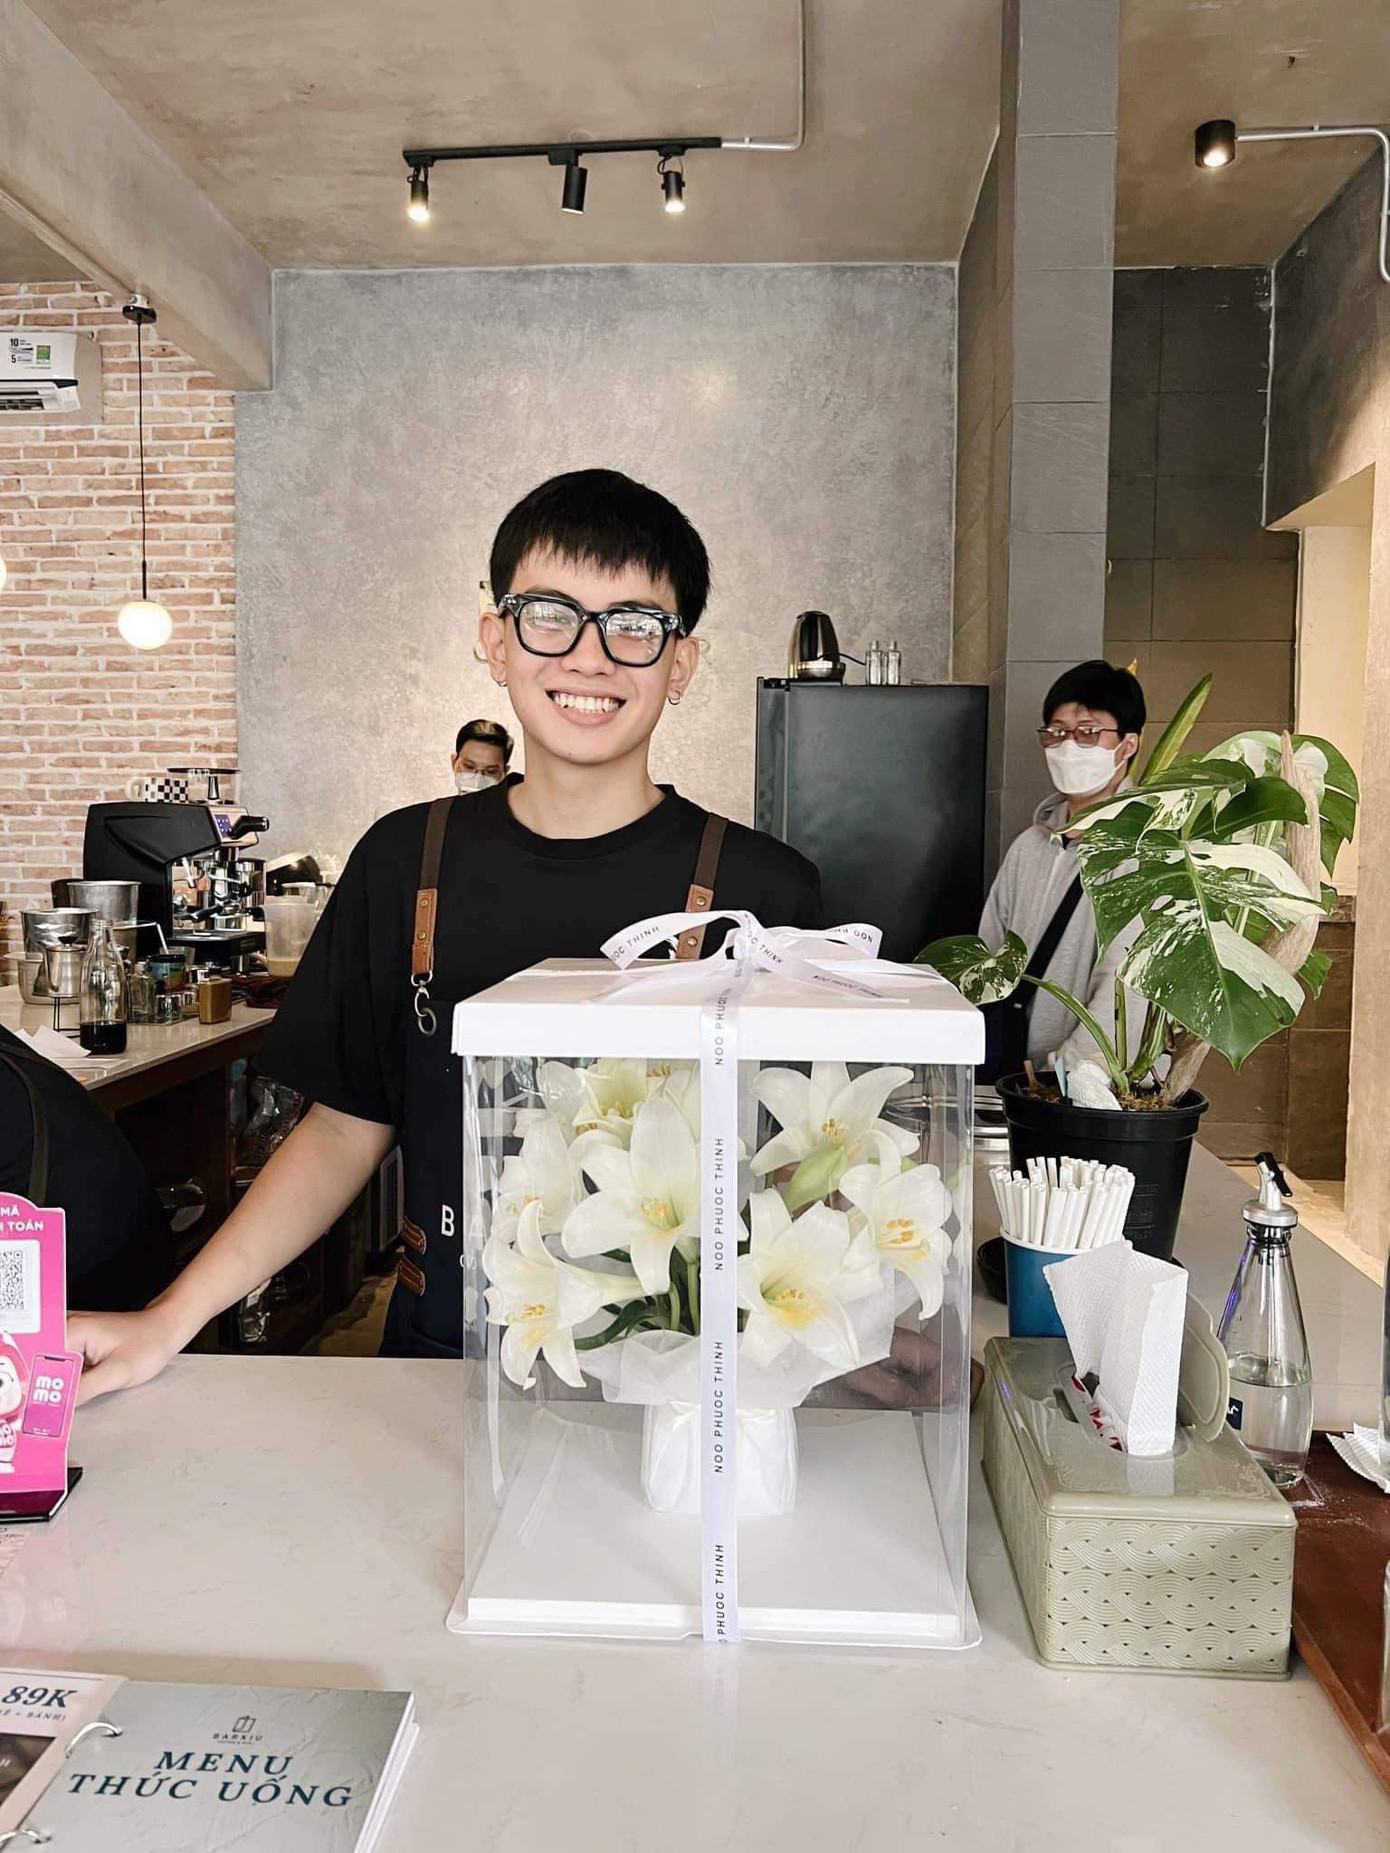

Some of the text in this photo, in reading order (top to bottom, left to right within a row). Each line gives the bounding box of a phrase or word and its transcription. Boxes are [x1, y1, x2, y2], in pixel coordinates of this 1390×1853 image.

[10, 338, 19, 347] 10
[11, 354, 17, 364] 5
[626, 926, 660, 947] THINH
[714, 1036, 724, 1066] NOO
[714, 1137, 724, 1271] NOO PHUOC THINH
[8, 1219, 44, 1232] TOÁN
[714, 1341, 724, 1474] NOO PHUOC THINH
[714, 1543, 725, 1585] THINH
[715, 1591, 726, 1636] PHUOC
[3, 1685, 78, 1708] 89K
[153, 1751, 293, 1775] MENU
[68, 1771, 352, 1807] THỨC UỐNG
